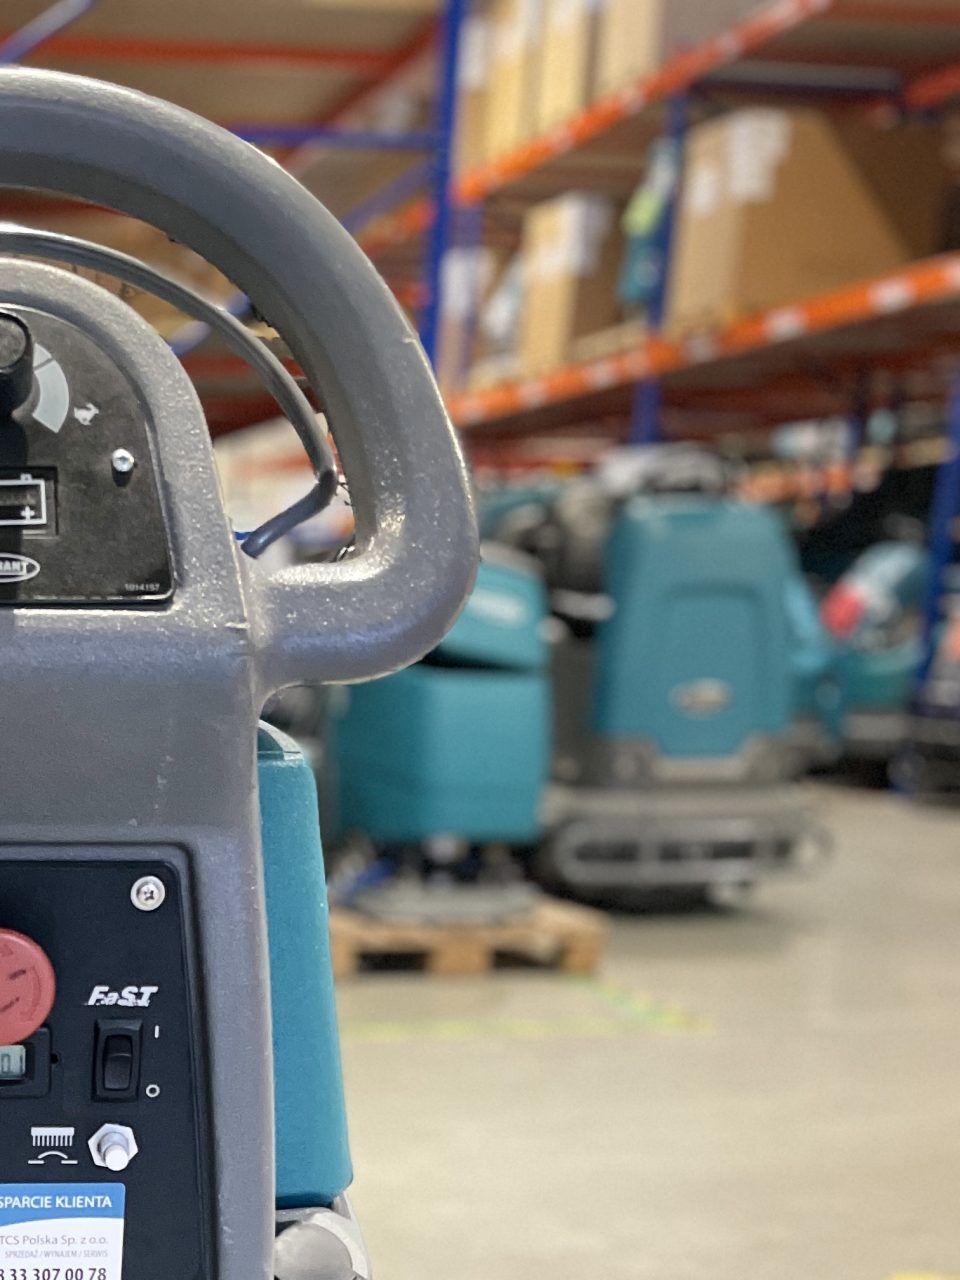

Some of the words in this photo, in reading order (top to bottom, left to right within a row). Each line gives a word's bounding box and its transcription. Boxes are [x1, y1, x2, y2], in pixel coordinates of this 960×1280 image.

[56, 1195, 112, 1208] KLIENTA
[0, 1235, 20, 1245] TCS
[22, 1234, 58, 1245] Polska
[61, 1235, 78, 1246] Sp.
[81, 1237, 87, 1245] z
